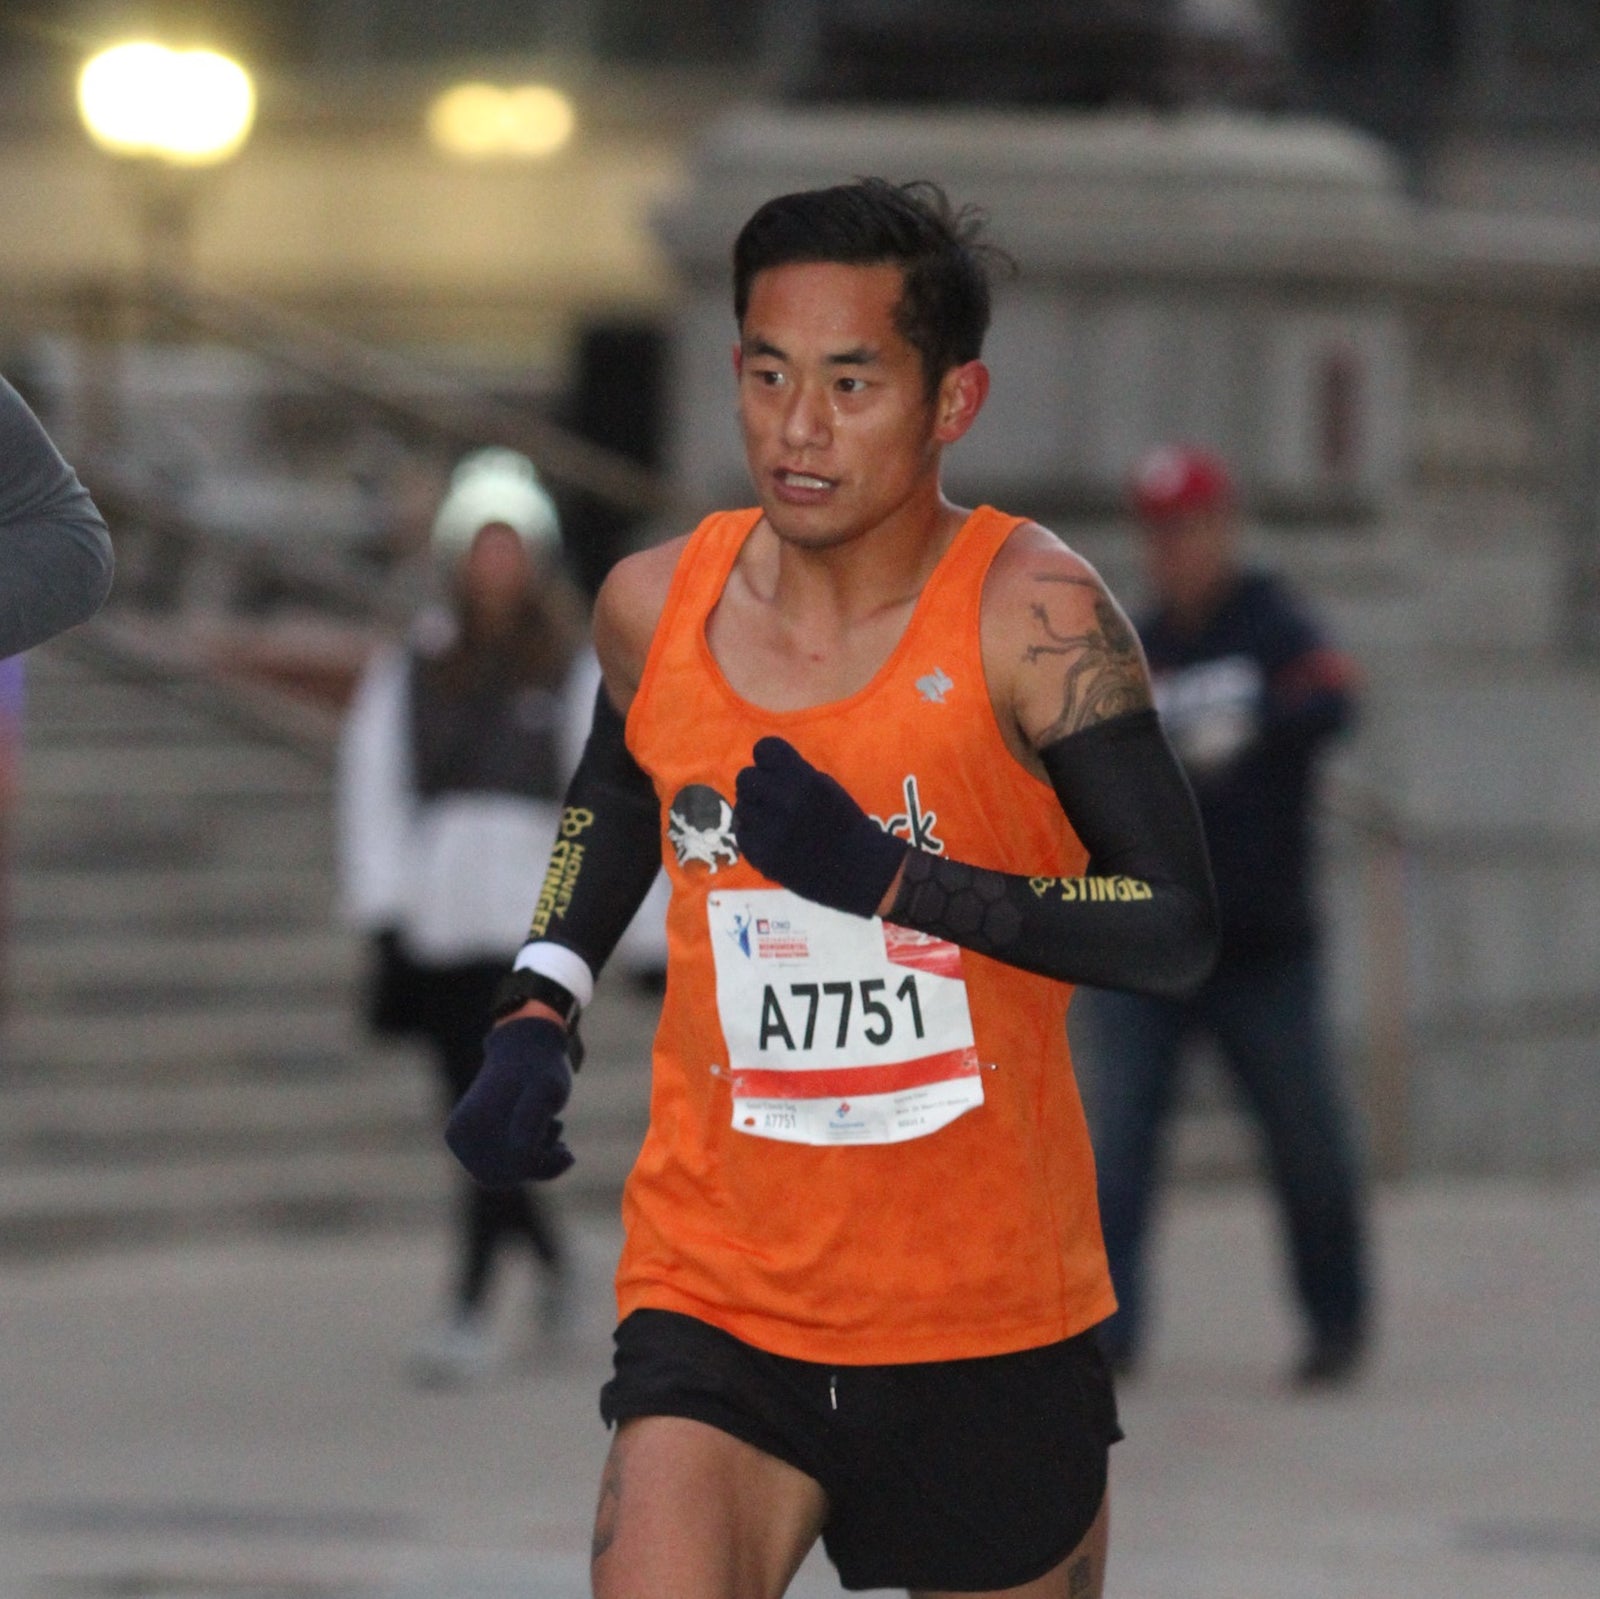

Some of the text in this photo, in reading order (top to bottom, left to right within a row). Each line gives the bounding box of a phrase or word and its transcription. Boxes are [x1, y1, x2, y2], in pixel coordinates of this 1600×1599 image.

[555, 842, 585, 919] HONEY
[758, 974, 925, 1051] A7751
[764, 1113, 796, 1129] A7751
